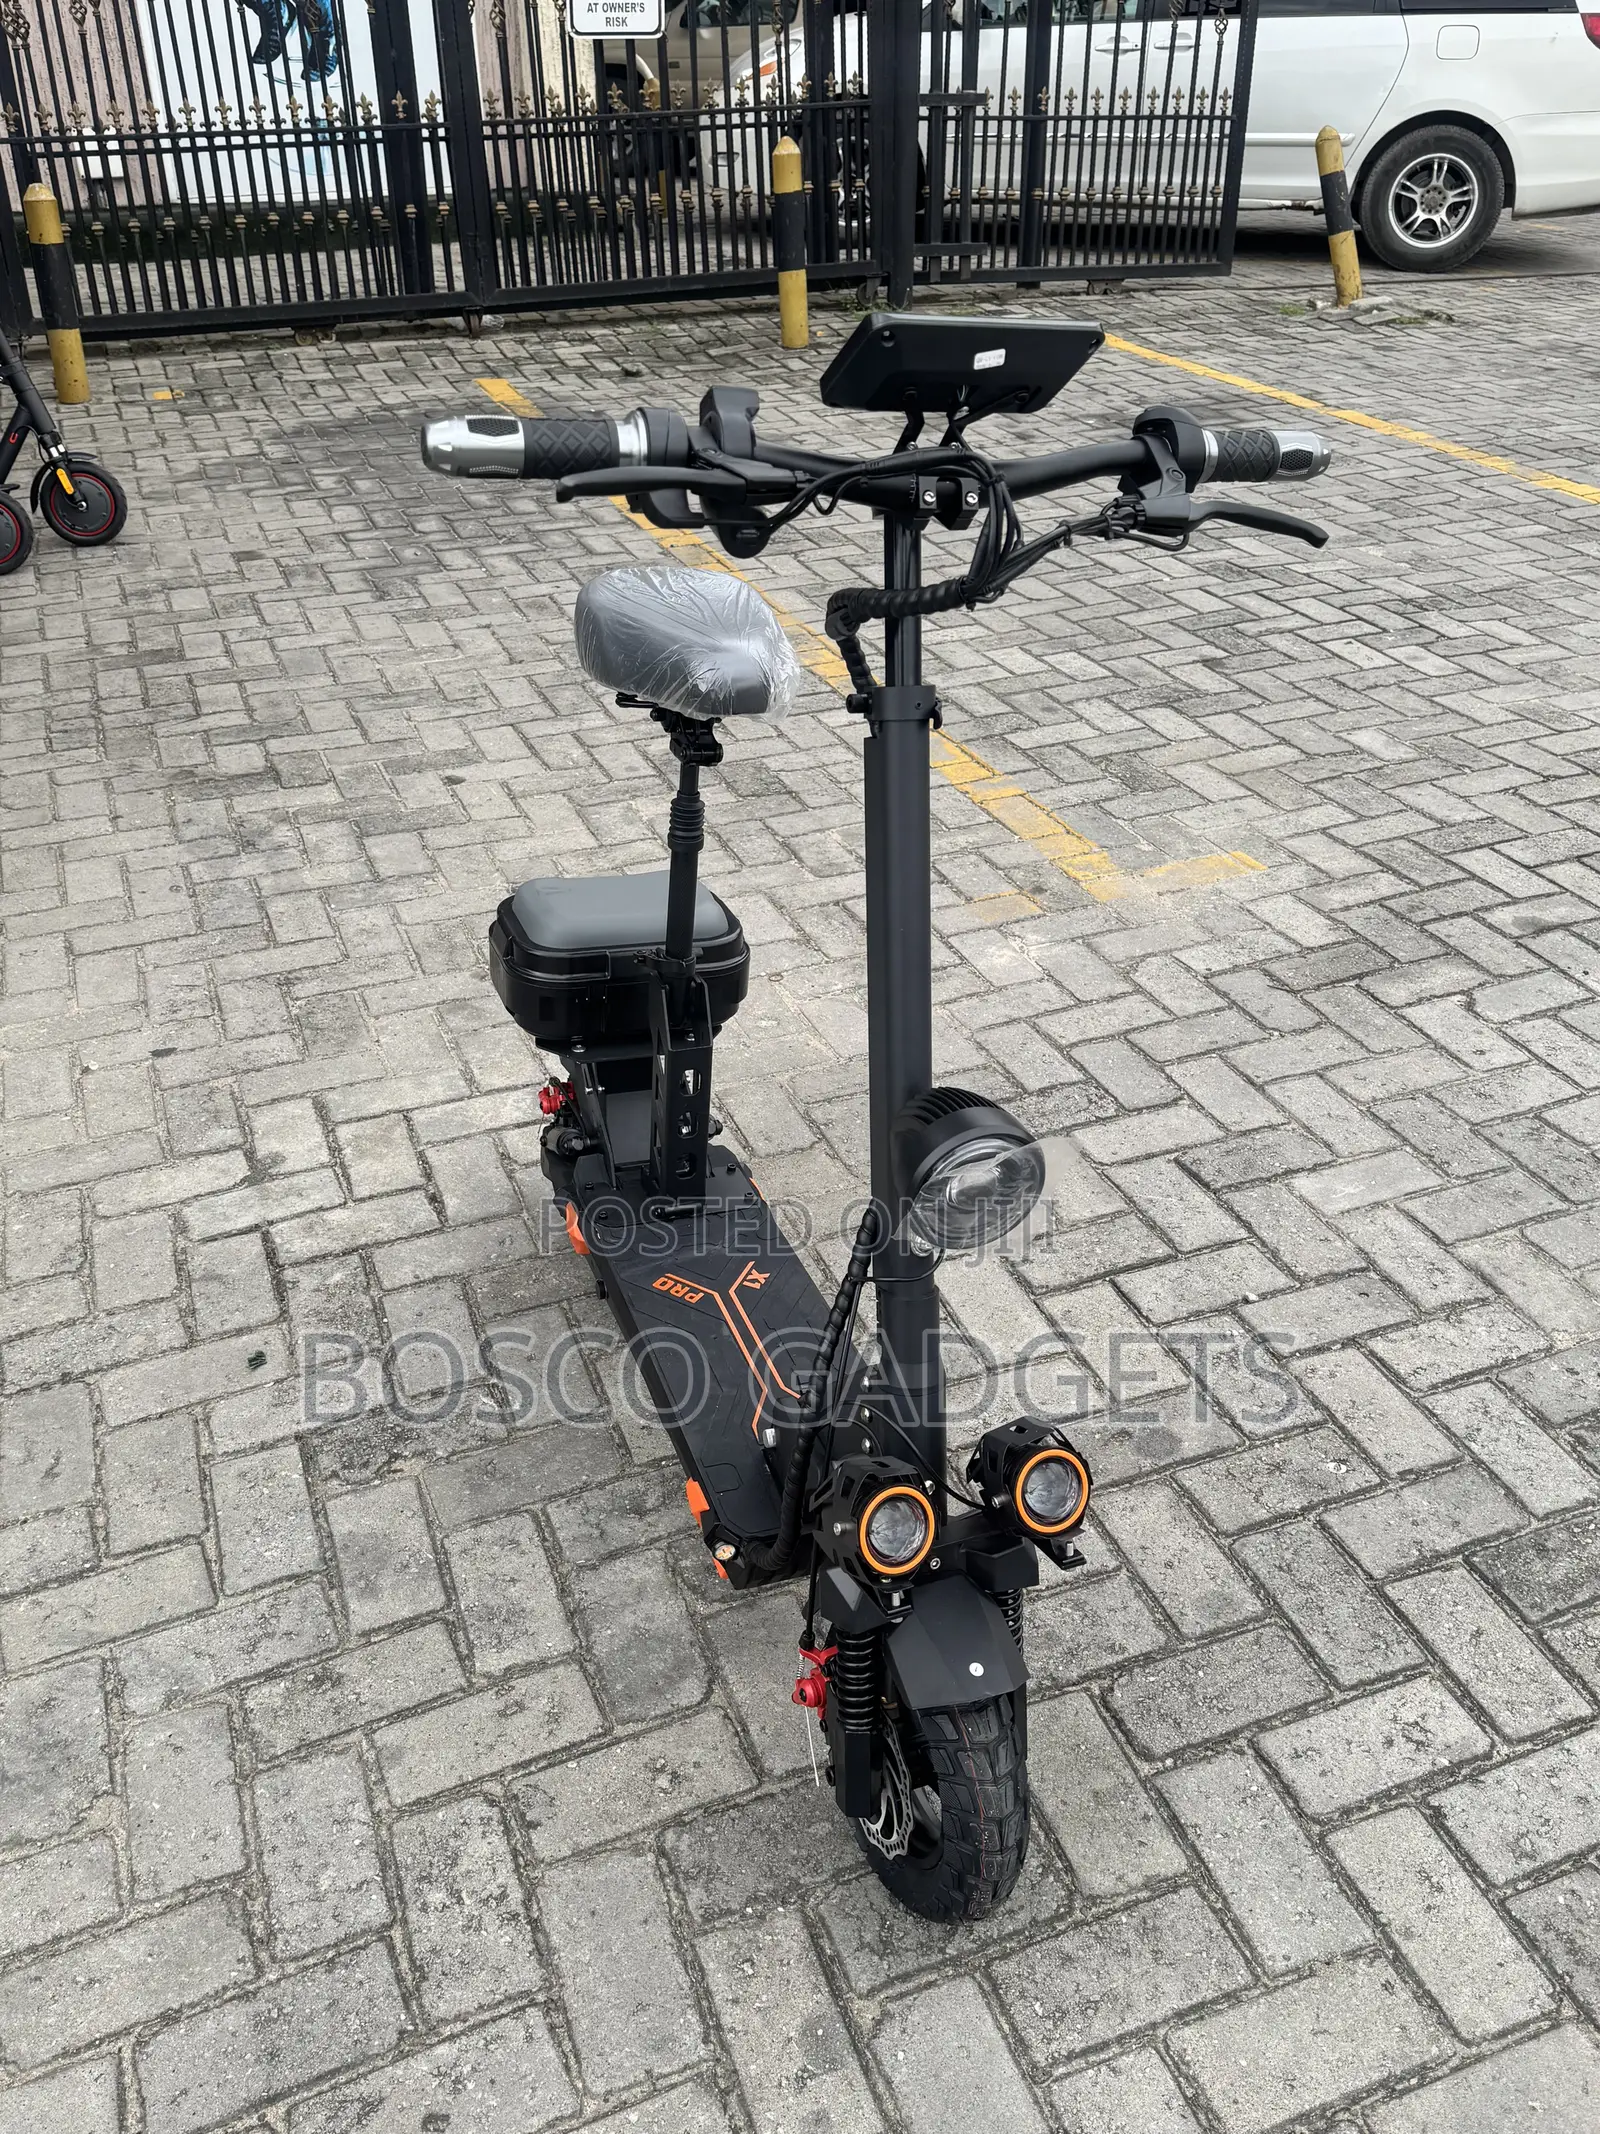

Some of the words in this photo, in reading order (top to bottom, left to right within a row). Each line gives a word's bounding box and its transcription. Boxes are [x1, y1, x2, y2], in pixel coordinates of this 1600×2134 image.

[586, 2, 599, 13] AT
[601, 2, 645, 13] OWNER'S
[605, 16, 628, 27] RISK
[742, 1268, 771, 1290] X1
[652, 1276, 705, 1304] PRO
